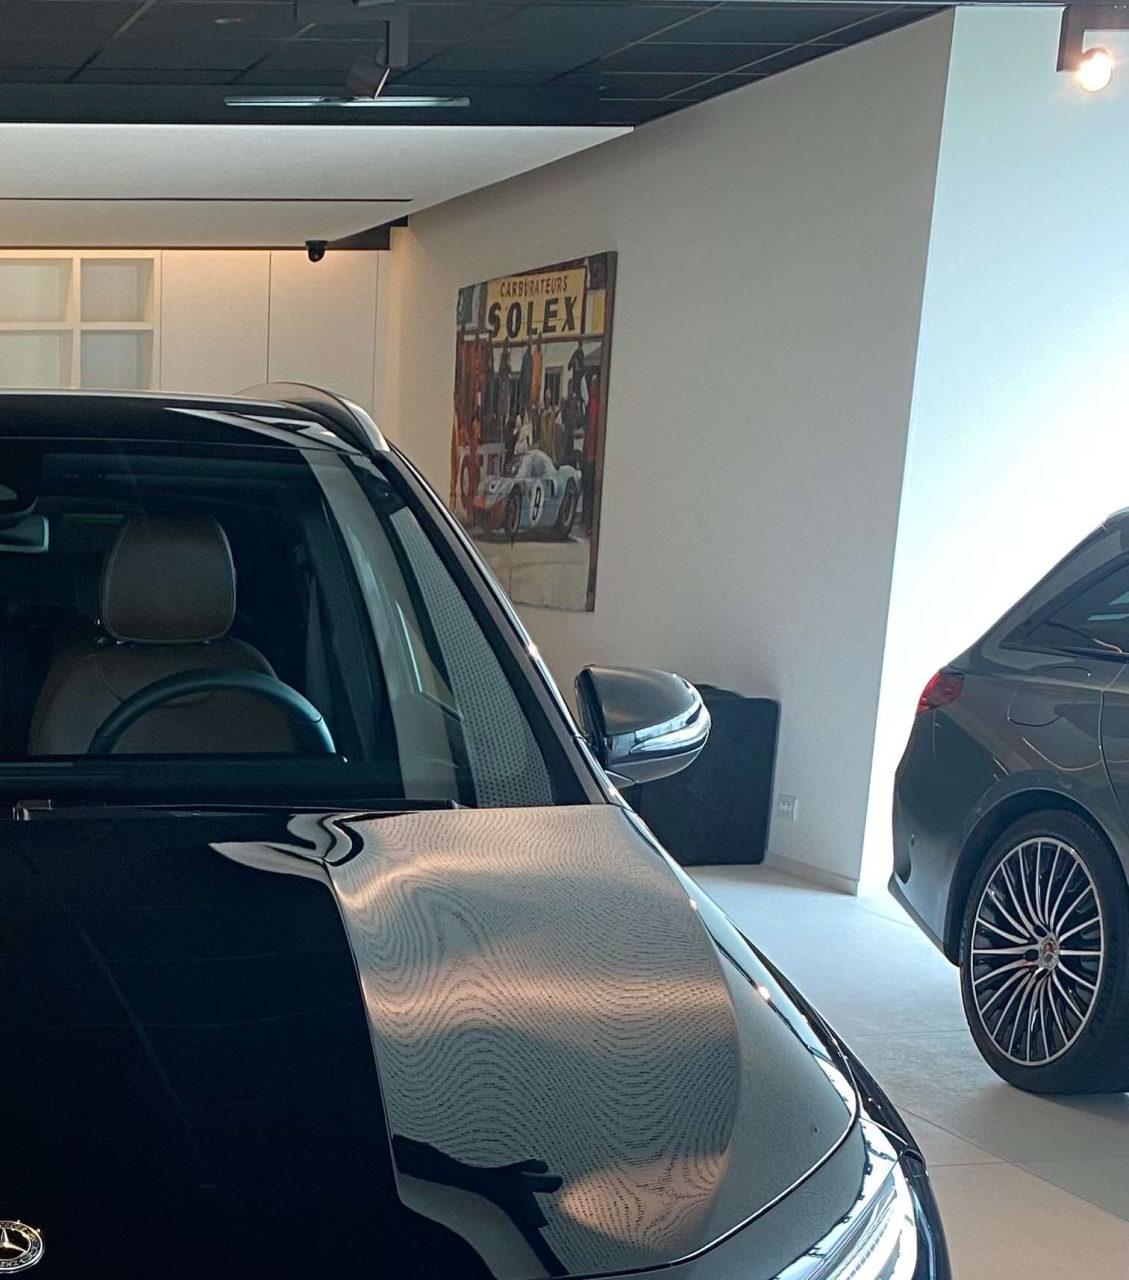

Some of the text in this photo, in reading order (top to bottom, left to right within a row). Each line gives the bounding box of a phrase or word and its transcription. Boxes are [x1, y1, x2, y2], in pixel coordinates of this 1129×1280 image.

[500, 276, 568, 296] CARBURATEURS
[488, 296, 577, 339] SOLEX
[531, 487, 541, 521] 9
